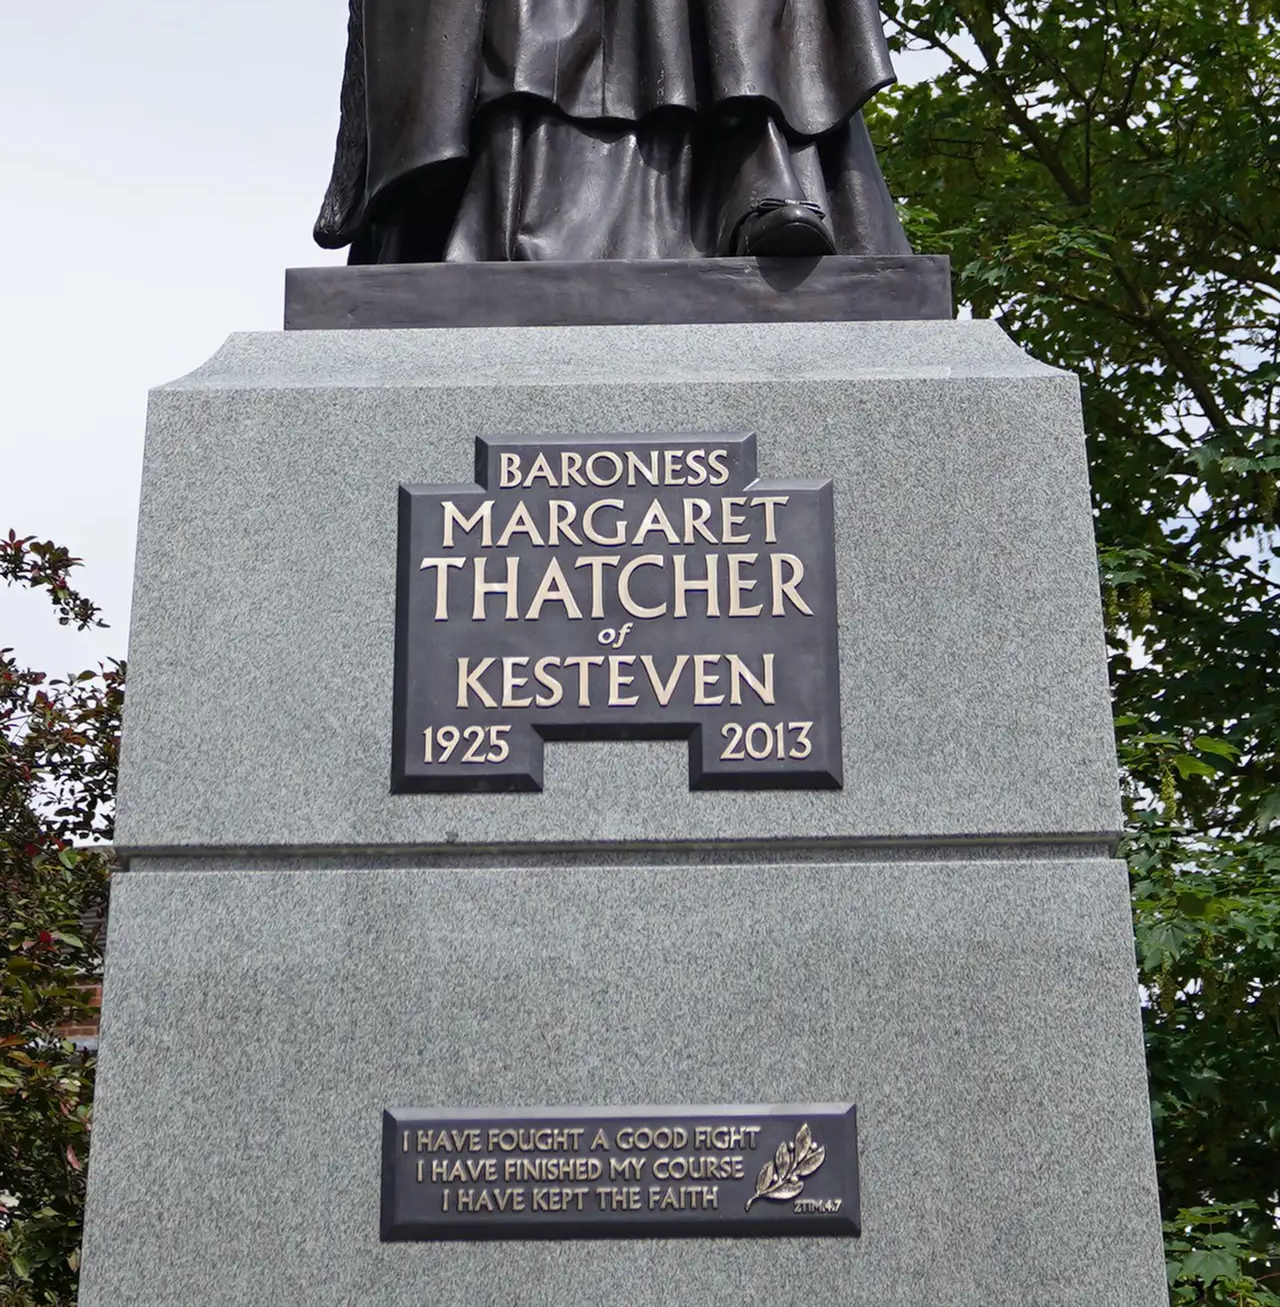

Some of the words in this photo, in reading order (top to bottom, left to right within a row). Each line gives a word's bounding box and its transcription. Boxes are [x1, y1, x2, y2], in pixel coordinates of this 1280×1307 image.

[499, 449, 730, 489] BARONESS
[441, 496, 790, 548] MARGARET
[419, 553, 814, 621] THATCHER
[597, 623, 634, 649] of
[456, 654, 776, 709] KESTEVEN
[421, 724, 513, 764] 1925
[719, 721, 815, 761] 2013
[402, 1129, 410, 1152] I
[416, 1129, 482, 1152] HAVE
[487, 1128, 584, 1151] FOUGHT
[590, 1128, 610, 1150] A
[616, 1127, 688, 1150] GOOD
[694, 1126, 762, 1149] FIGHT
[417, 1159, 425, 1182] I
[431, 1159, 498, 1182] HAVE
[504, 1158, 603, 1181] FINISHED
[609, 1157, 646, 1180] MY
[652, 1156, 745, 1179] COURSE
[442, 1189, 450, 1212] I
[457, 1189, 526, 1212] HAVE
[532, 1188, 590, 1211] KEPT
[596, 1187, 642, 1210] THE
[648, 1186, 719, 1210] FAITH
